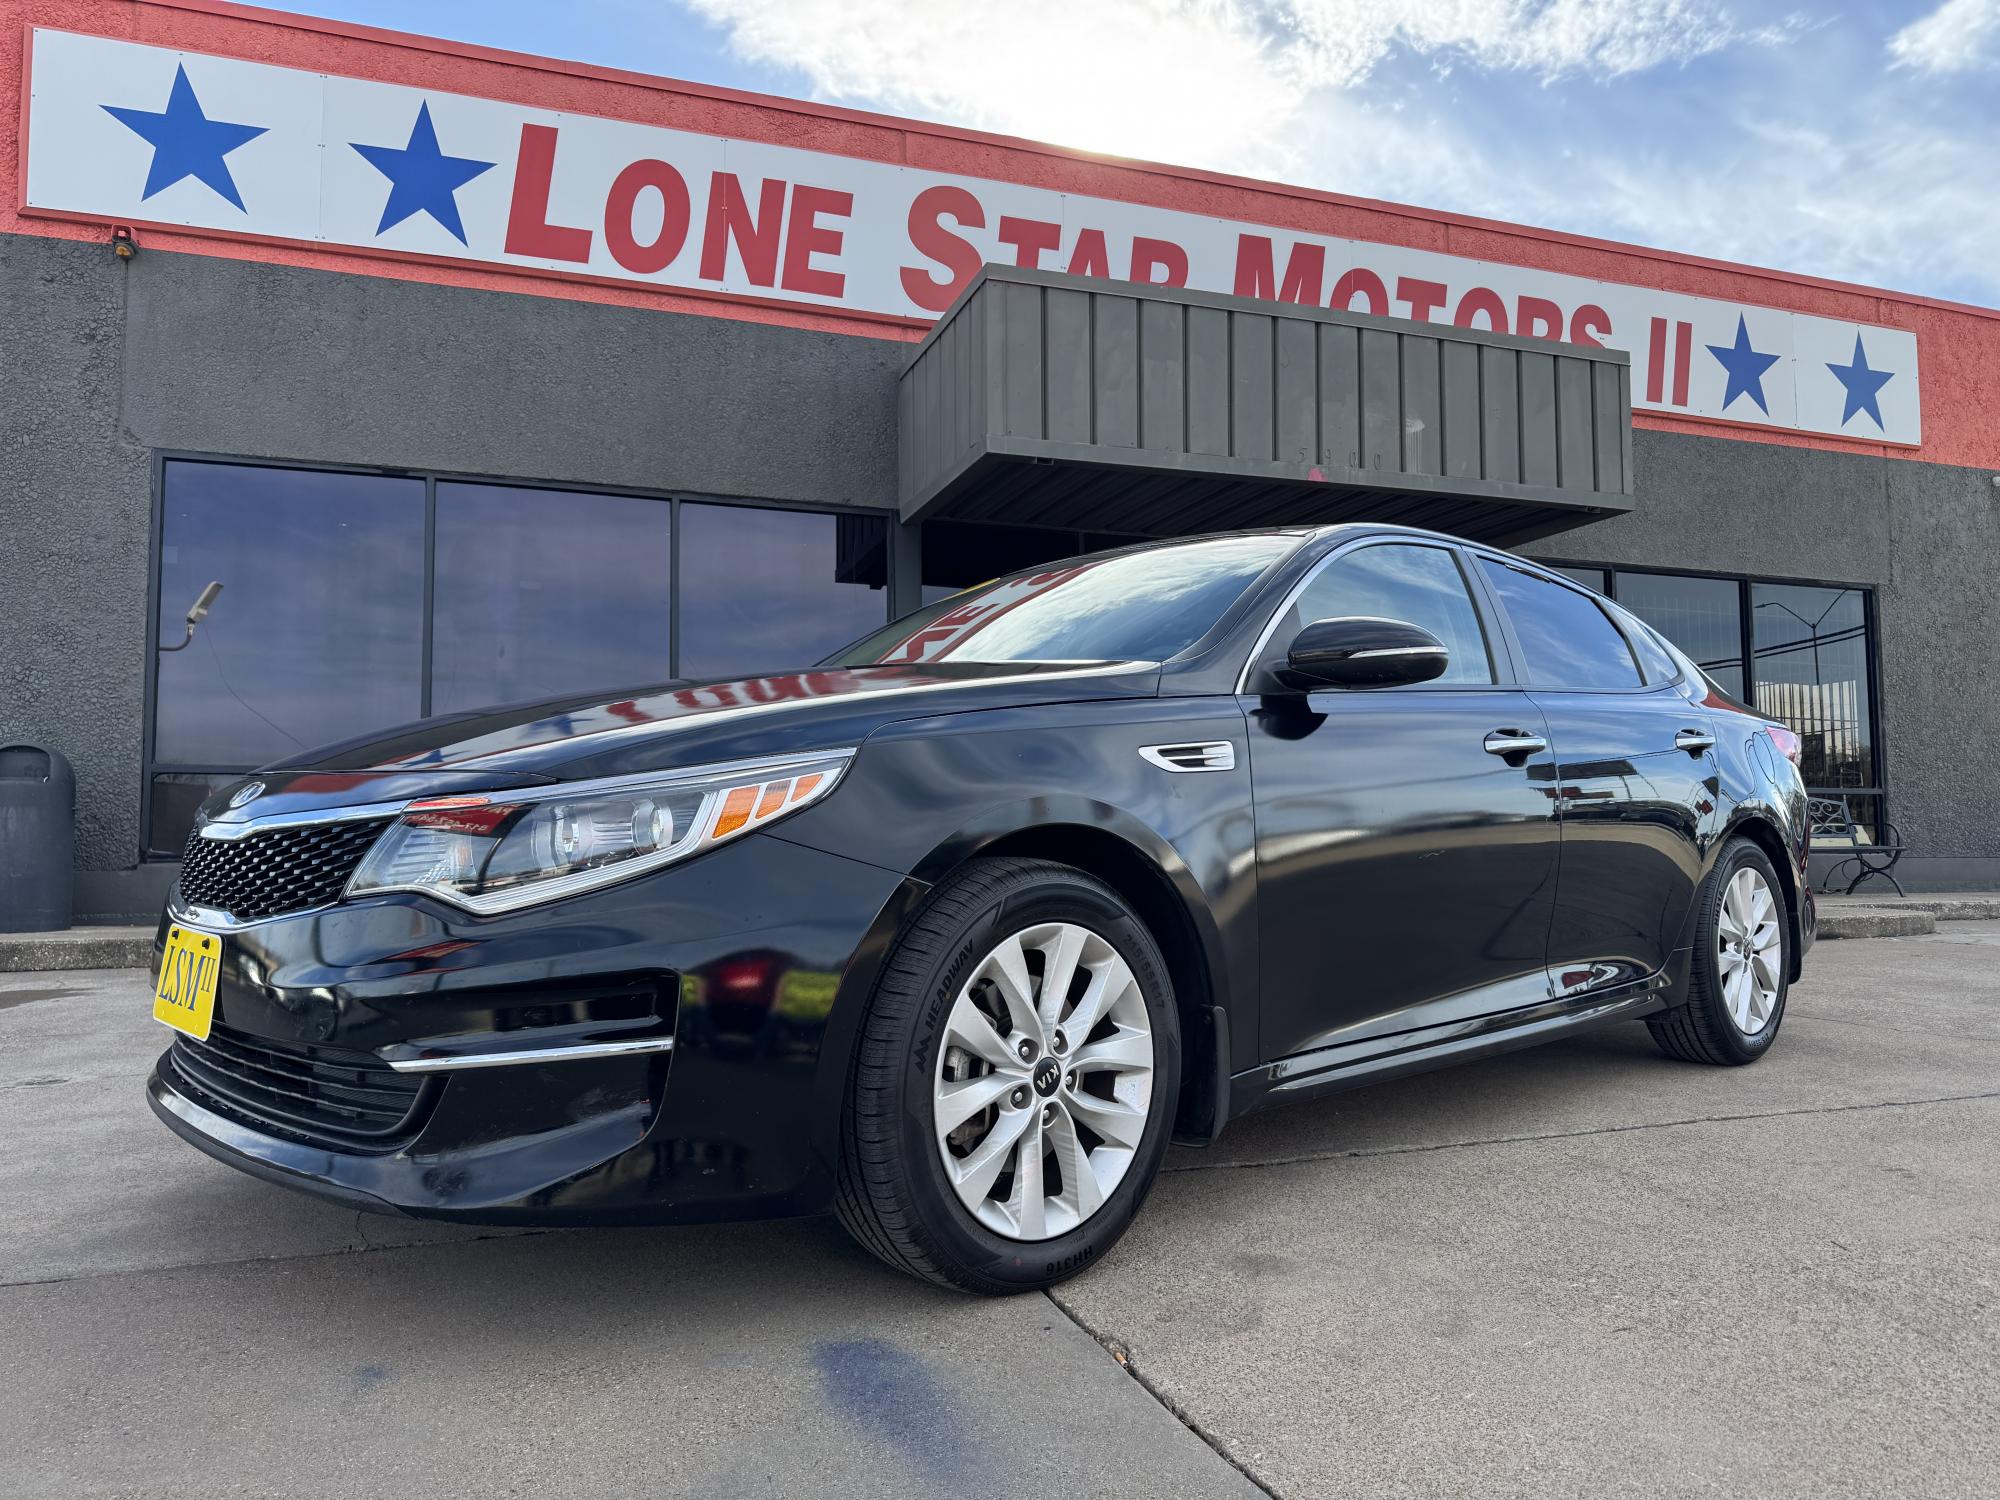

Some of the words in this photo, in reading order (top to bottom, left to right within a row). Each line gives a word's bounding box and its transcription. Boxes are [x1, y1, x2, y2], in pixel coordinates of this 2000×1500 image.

[504, 122, 853, 298] LONE
[1646, 317, 1693, 407] II
[925, 938, 974, 1032] HEADWAY
[1036, 1064, 1060, 1090] KIA
[1046, 1245, 1093, 1275] HH316
